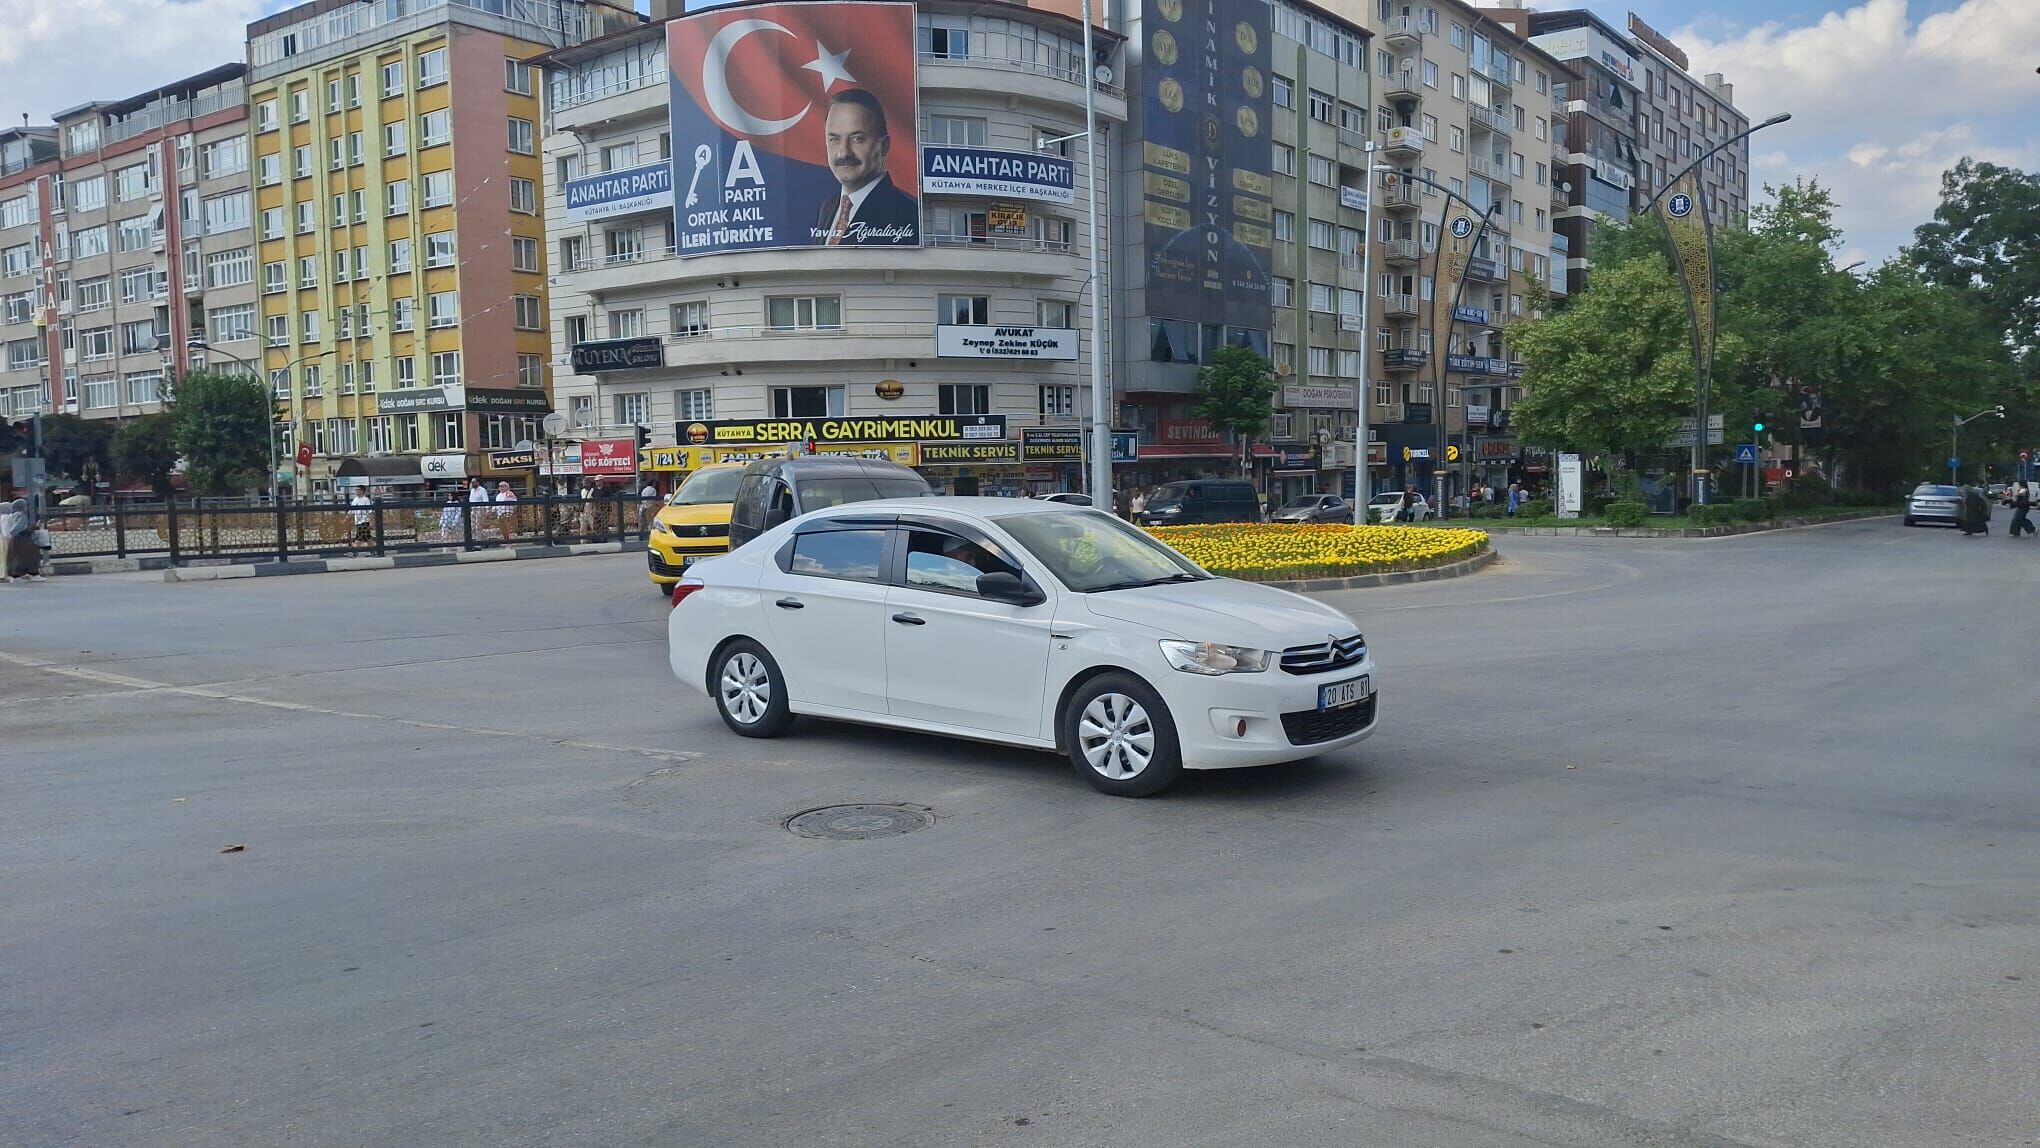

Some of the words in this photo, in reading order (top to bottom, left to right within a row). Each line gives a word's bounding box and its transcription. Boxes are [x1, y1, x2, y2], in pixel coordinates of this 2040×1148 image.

[725, 140, 765, 187] A
[931, 154, 1023, 178] ANAHTAR
[570, 177, 629, 204] ANAHTAR
[932, 180, 971, 189] KÜTAHYA
[976, 183, 1008, 192] MERKEZ
[1029, 188, 1069, 199] BAŞKANLIĞI
[688, 209, 729, 227] ORTAK
[732, 207, 764, 222] AKIL
[682, 228, 711, 249] İLERİ
[713, 224, 773, 245] TÜRKİYE
[810, 227, 842, 238] Yavuz
[43, 241, 56, 309] ATA
[995, 328, 1034, 337] AVUKAT
[1030, 338, 1058, 350] KÜÇÜK
[491, 397, 512, 405] DOĞAN
[756, 422, 816, 441] SERRA
[924, 444, 971, 459] TEKNİK
[973, 443, 1016, 458] SERVİS
[1025, 443, 1056, 455] TEKNİK
[427, 458, 447, 472] dek
[583, 456, 597, 469] ÇİĞ
[598, 455, 631, 467] KÖFTECİ
[655, 453, 673, 465] 7/24
[1327, 688, 1337, 704] 20
[1342, 684, 1355, 701] ATS
